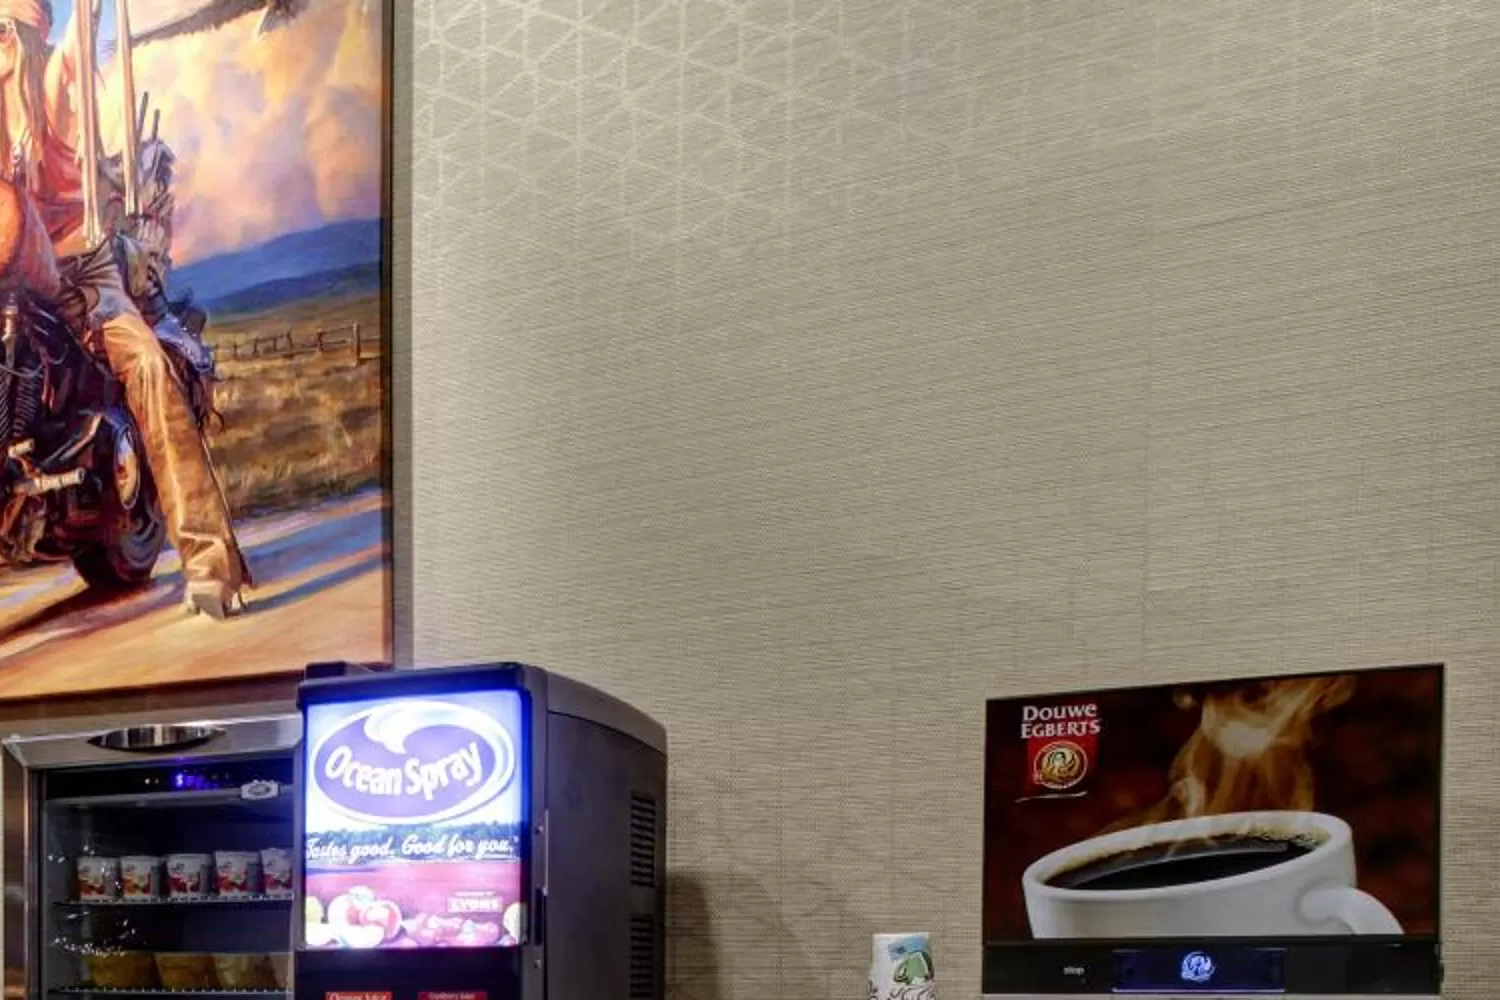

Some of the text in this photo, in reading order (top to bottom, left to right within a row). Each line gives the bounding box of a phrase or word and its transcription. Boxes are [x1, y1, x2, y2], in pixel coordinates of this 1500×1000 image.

[1020, 718, 1101, 739] EGBERTS
[324, 740, 482, 801] Ocean Spray
[402, 834, 445, 857] Good
[446, 834, 475, 859] for
